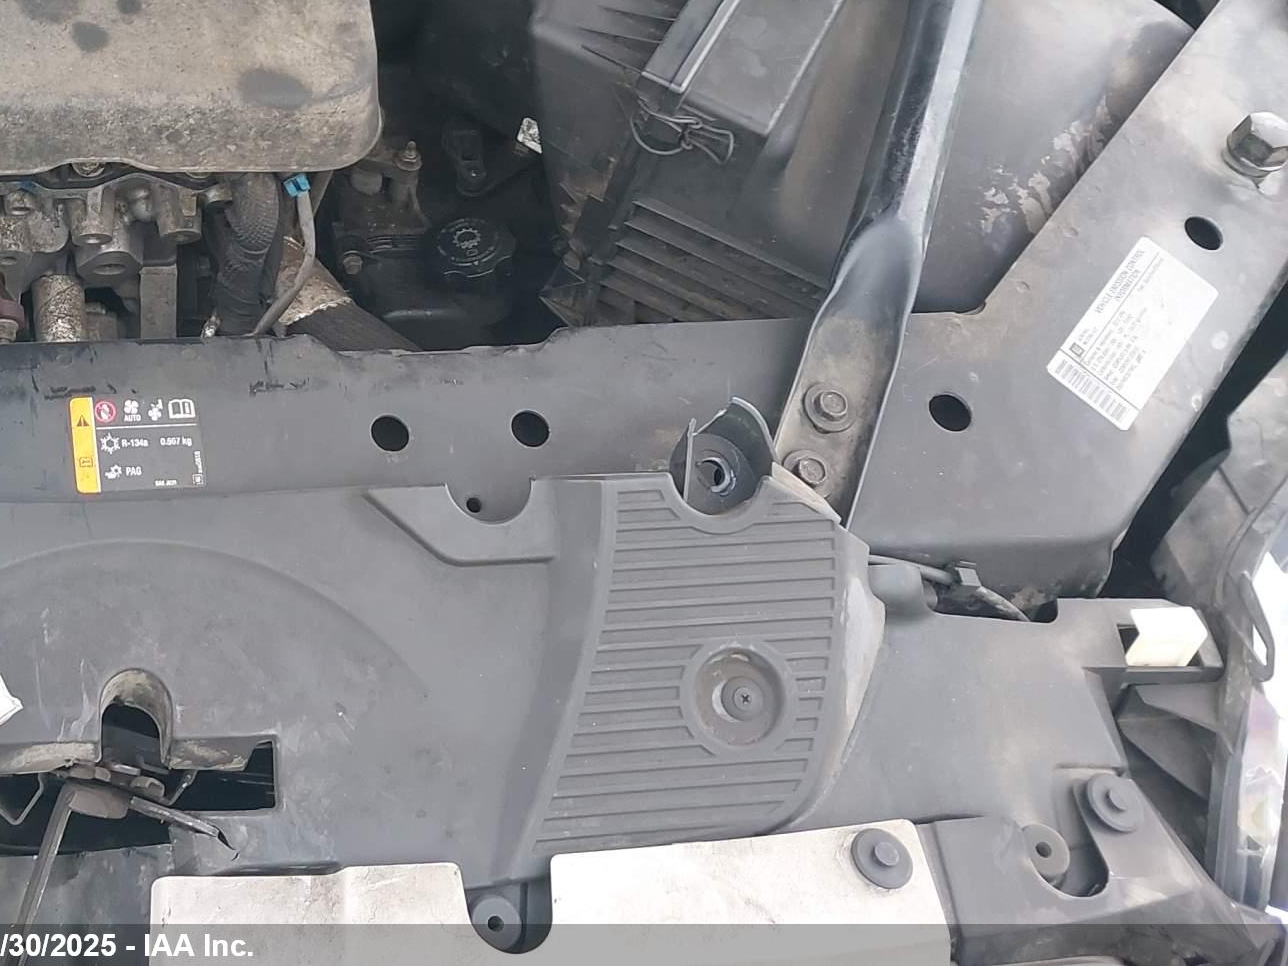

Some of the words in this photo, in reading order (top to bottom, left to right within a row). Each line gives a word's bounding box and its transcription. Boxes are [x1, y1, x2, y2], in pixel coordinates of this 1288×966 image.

[124, 414, 141, 422] AUTO
[122, 438, 149, 448] R-134a
[181, 436, 192, 446] kg
[126, 466, 142, 476] PAG
